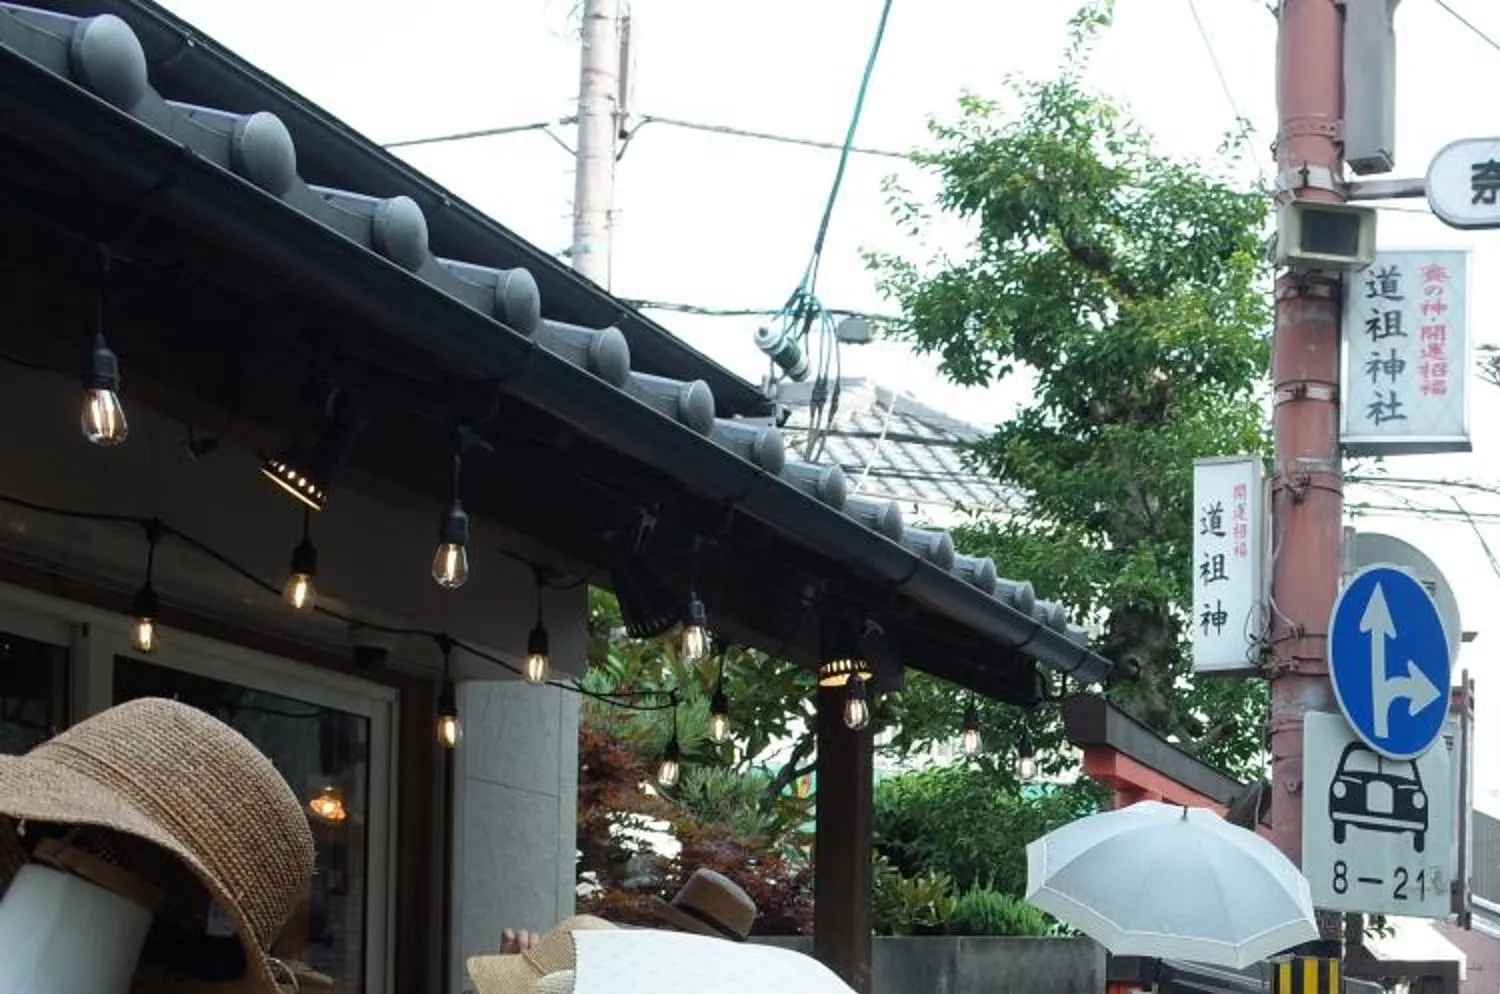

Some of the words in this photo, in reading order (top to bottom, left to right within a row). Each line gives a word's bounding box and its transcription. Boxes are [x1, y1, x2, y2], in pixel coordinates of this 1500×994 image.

[1365, 265, 1408, 427] 道祖神社
[1200, 501, 1229, 636] 道祖神
